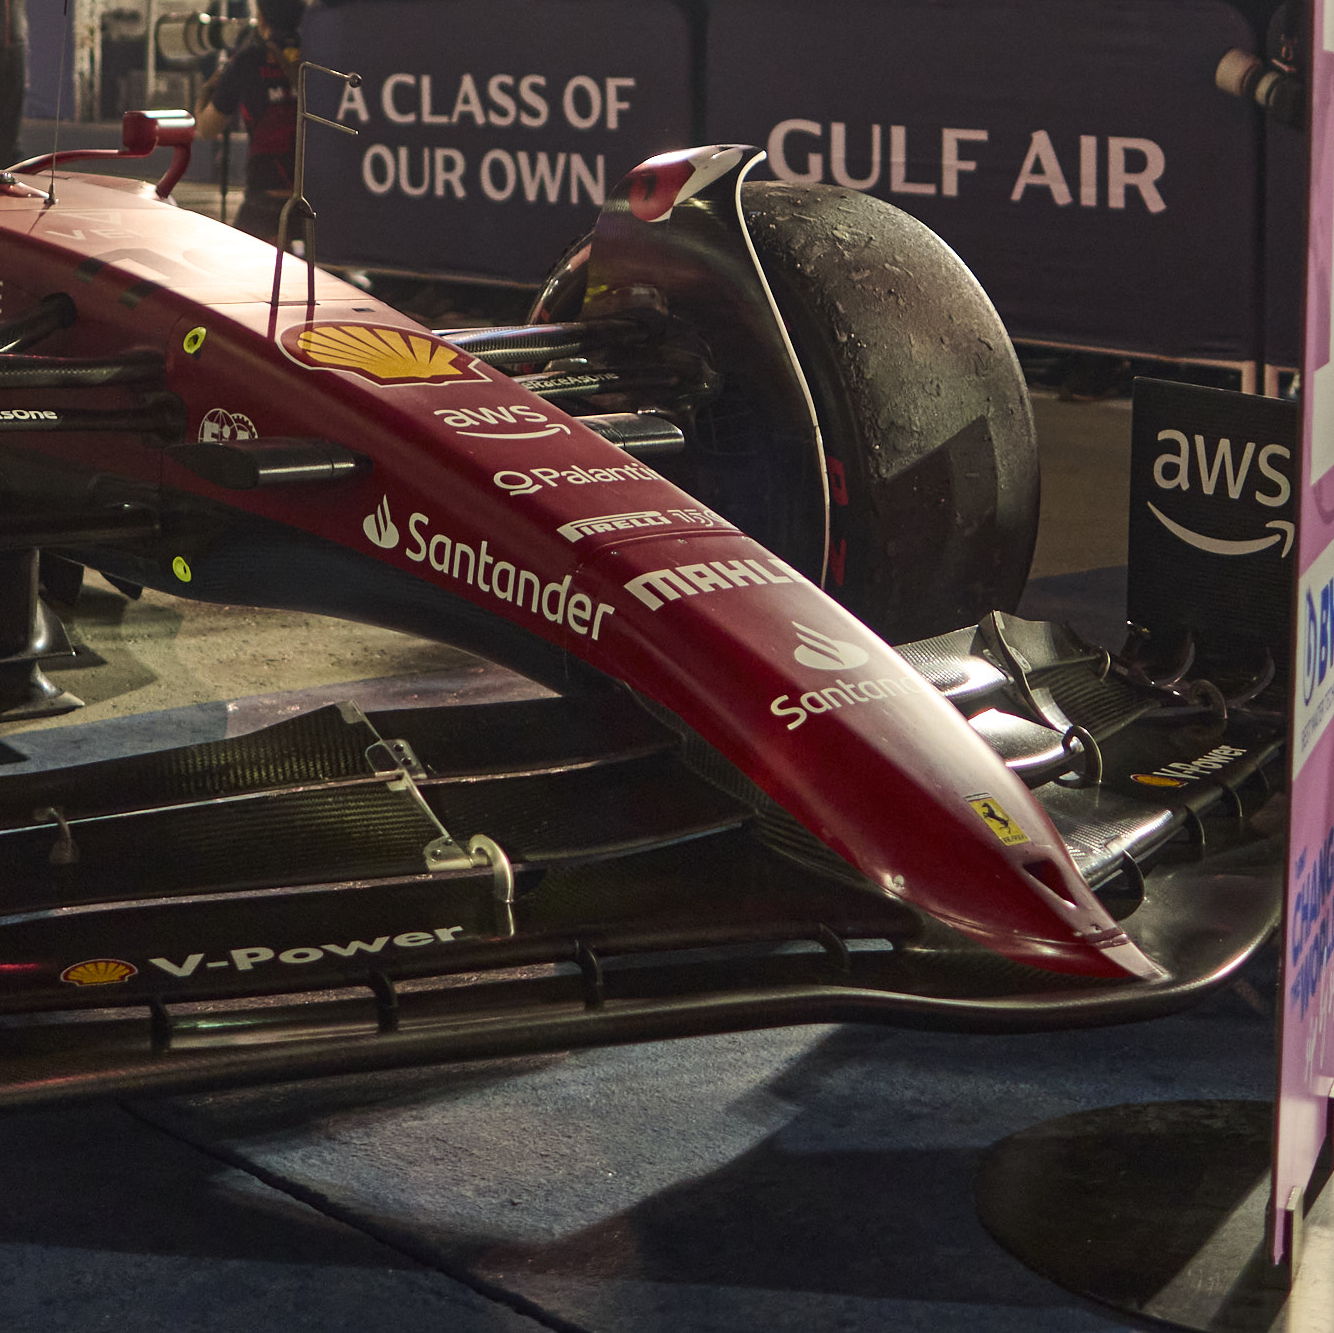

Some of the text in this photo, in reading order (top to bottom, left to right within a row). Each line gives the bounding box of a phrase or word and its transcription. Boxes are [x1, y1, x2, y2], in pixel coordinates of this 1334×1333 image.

[336, 72, 636, 131] A CLASS OF
[362, 143, 607, 206] OUR OWN
[767, 119, 1169, 214] GULF AIR
[433, 403, 548, 429] aws
[1152, 428, 1293, 508] aws
[556, 510, 672, 544] PIRELLI
[405, 512, 616, 642] Santander
[1153, 744, 1247, 780] V-Power
[149, 922, 465, 978] V-Power
